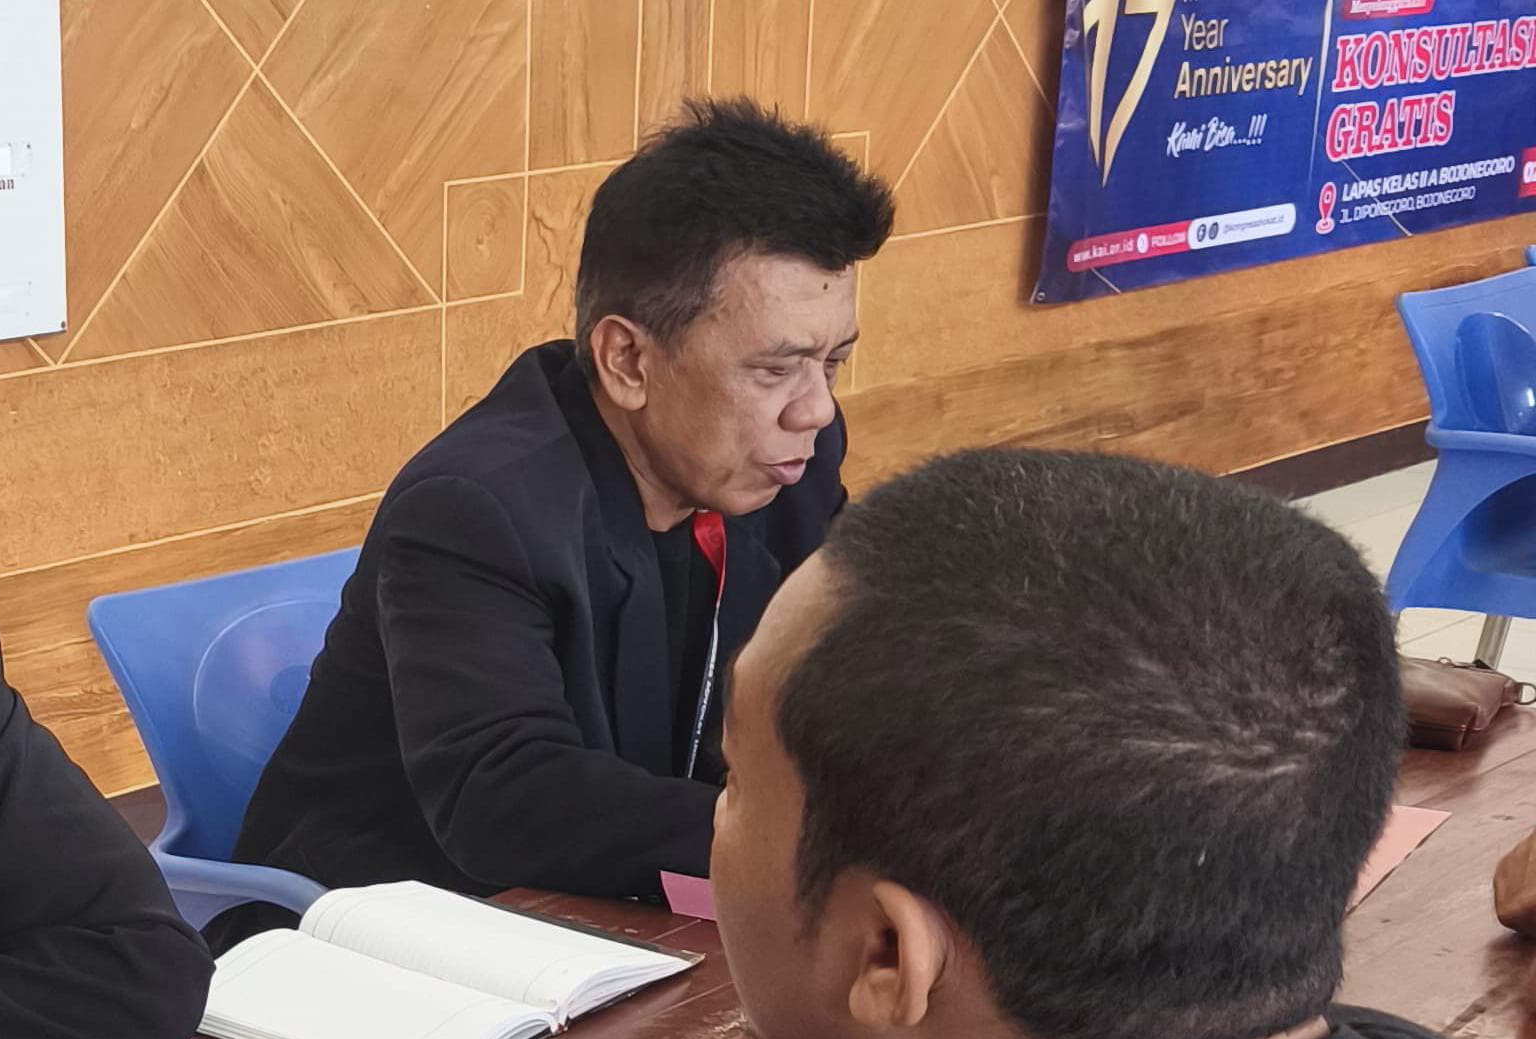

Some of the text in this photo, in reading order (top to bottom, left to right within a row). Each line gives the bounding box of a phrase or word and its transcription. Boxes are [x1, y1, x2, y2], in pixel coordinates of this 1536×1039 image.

[1181, 13, 1229, 51] Year
[1332, 16, 1536, 93] KONSULTASI
[1174, 56, 1313, 99] Anniversary
[1167, 121, 1206, 158] Kami
[1326, 90, 1456, 163] GRATIS
[1342, 181, 1381, 201] LAPAS
[1382, 172, 1415, 194] KELAS
[1426, 168, 1438, 187] A
[1439, 155, 1515, 185] BOJONEGORO
[1416, 186, 1476, 208] BOJONEGORO
